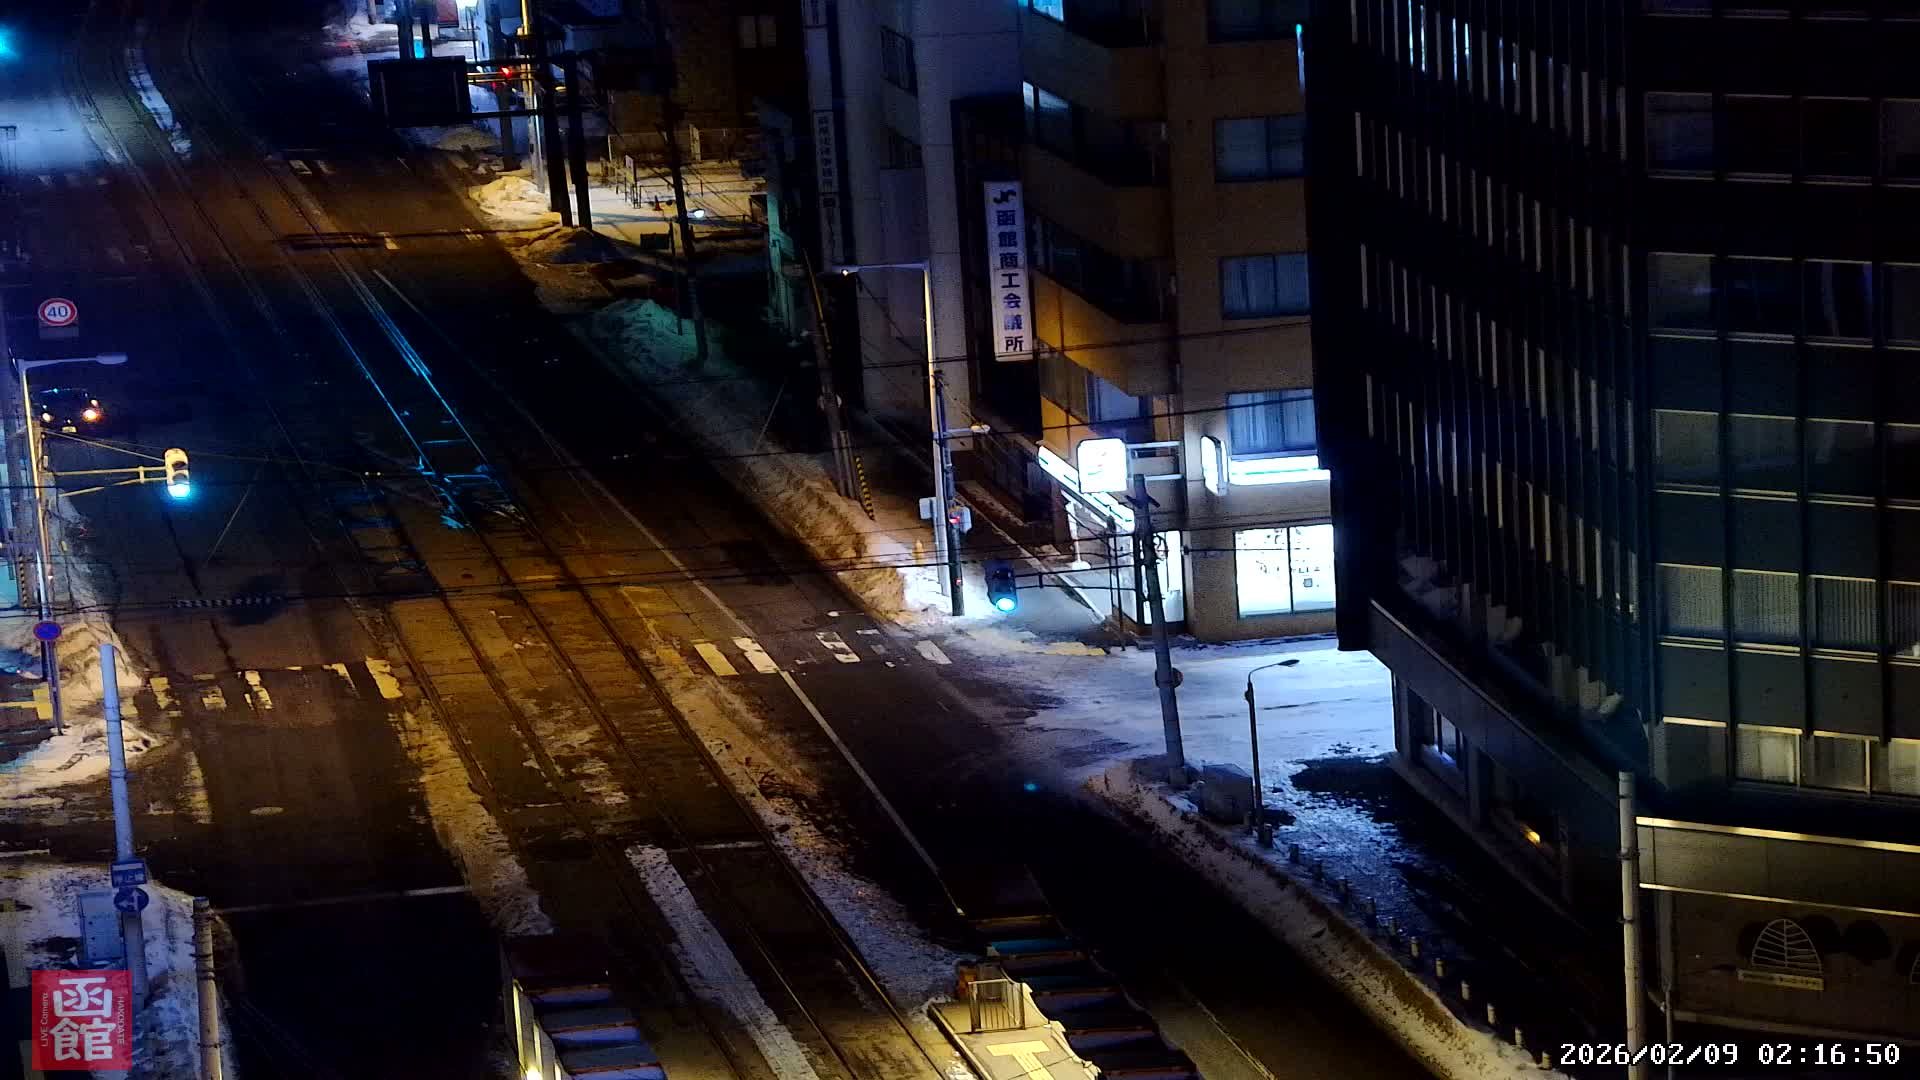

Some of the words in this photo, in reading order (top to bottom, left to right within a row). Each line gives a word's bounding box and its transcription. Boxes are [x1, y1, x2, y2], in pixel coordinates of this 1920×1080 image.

[47, 305, 68, 317] 40
[996, 210, 1024, 352] 函館商工会議所
